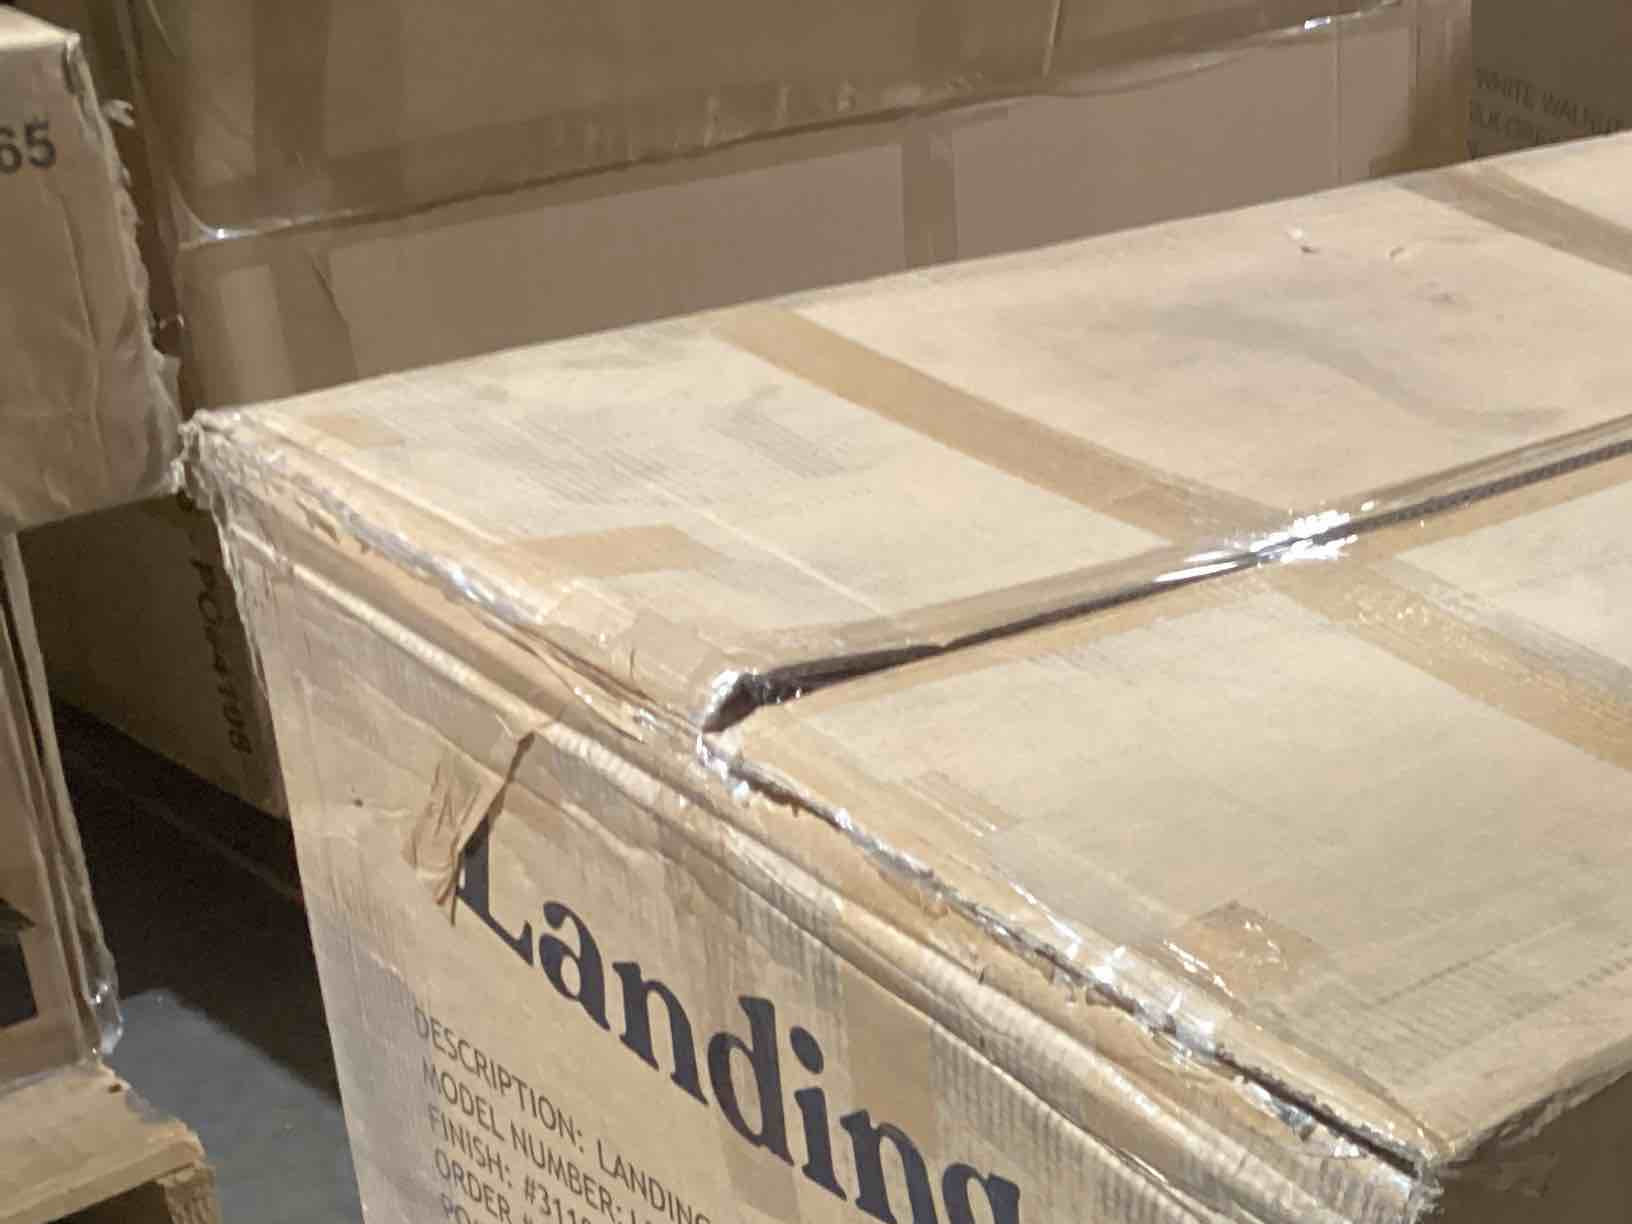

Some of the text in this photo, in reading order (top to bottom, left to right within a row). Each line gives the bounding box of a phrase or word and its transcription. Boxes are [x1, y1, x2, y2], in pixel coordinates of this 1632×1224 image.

[414, 1004, 584, 1153] DESCRIPTION:
[423, 1056, 504, 1141] MODEL
[428, 1103, 512, 1189] FINISH:
